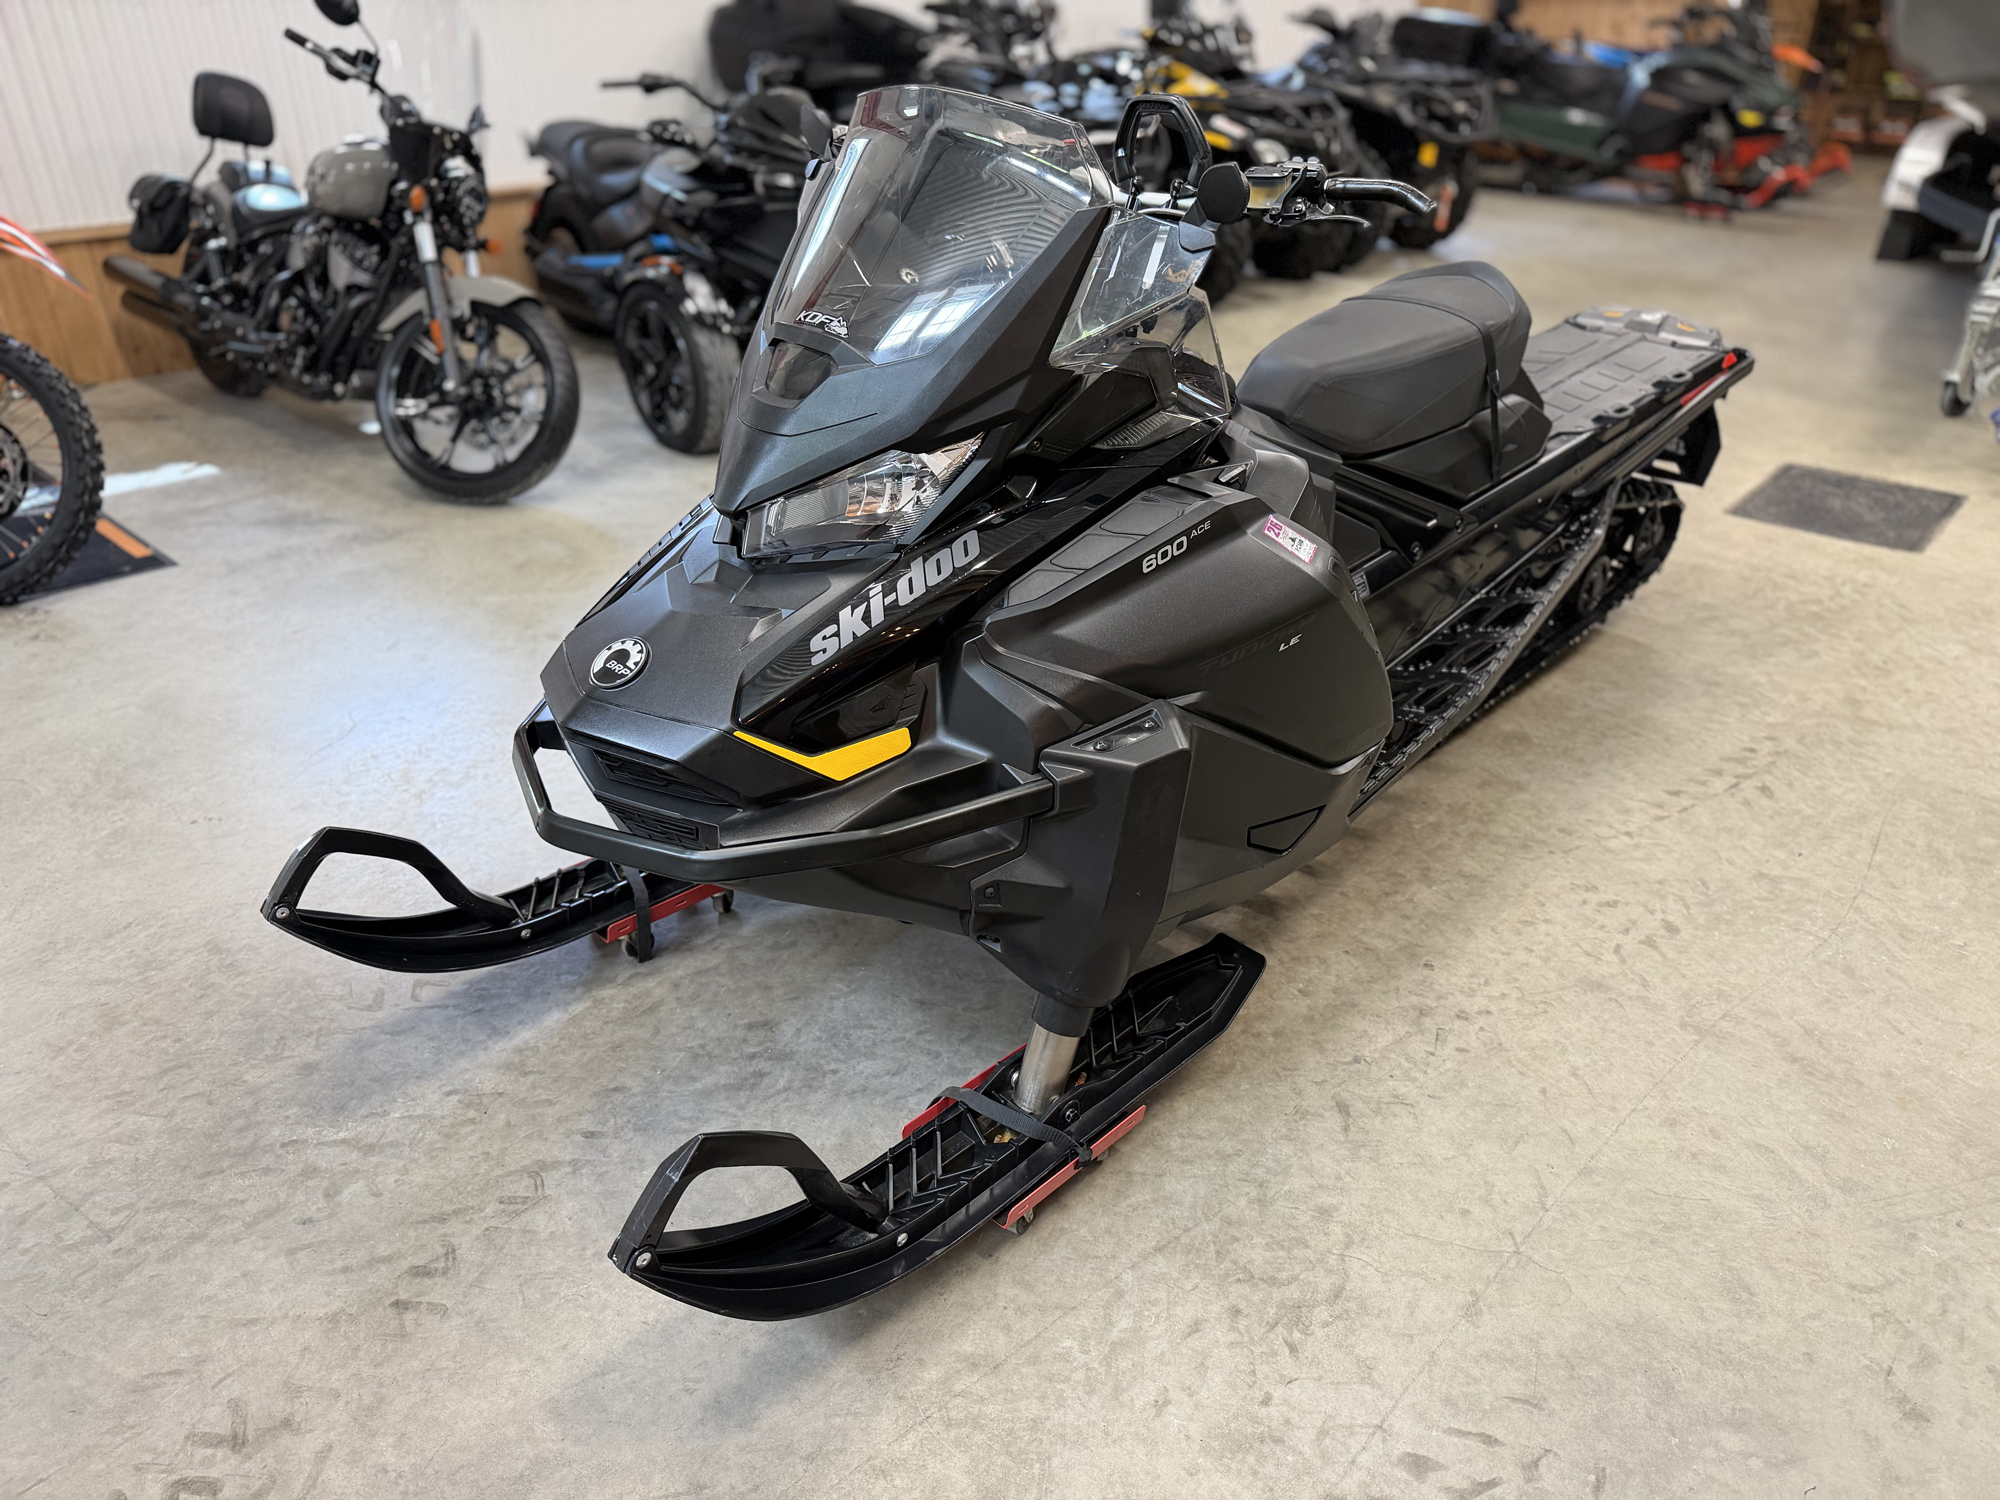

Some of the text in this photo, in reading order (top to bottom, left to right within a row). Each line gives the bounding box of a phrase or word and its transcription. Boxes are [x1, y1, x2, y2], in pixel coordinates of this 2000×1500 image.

[1266, 519, 1283, 538] 26
[1142, 520, 1212, 574] 600 ACE
[810, 529, 981, 666] ski-doo
[1278, 633, 1302, 652] LE
[605, 659, 631, 675] BRP
